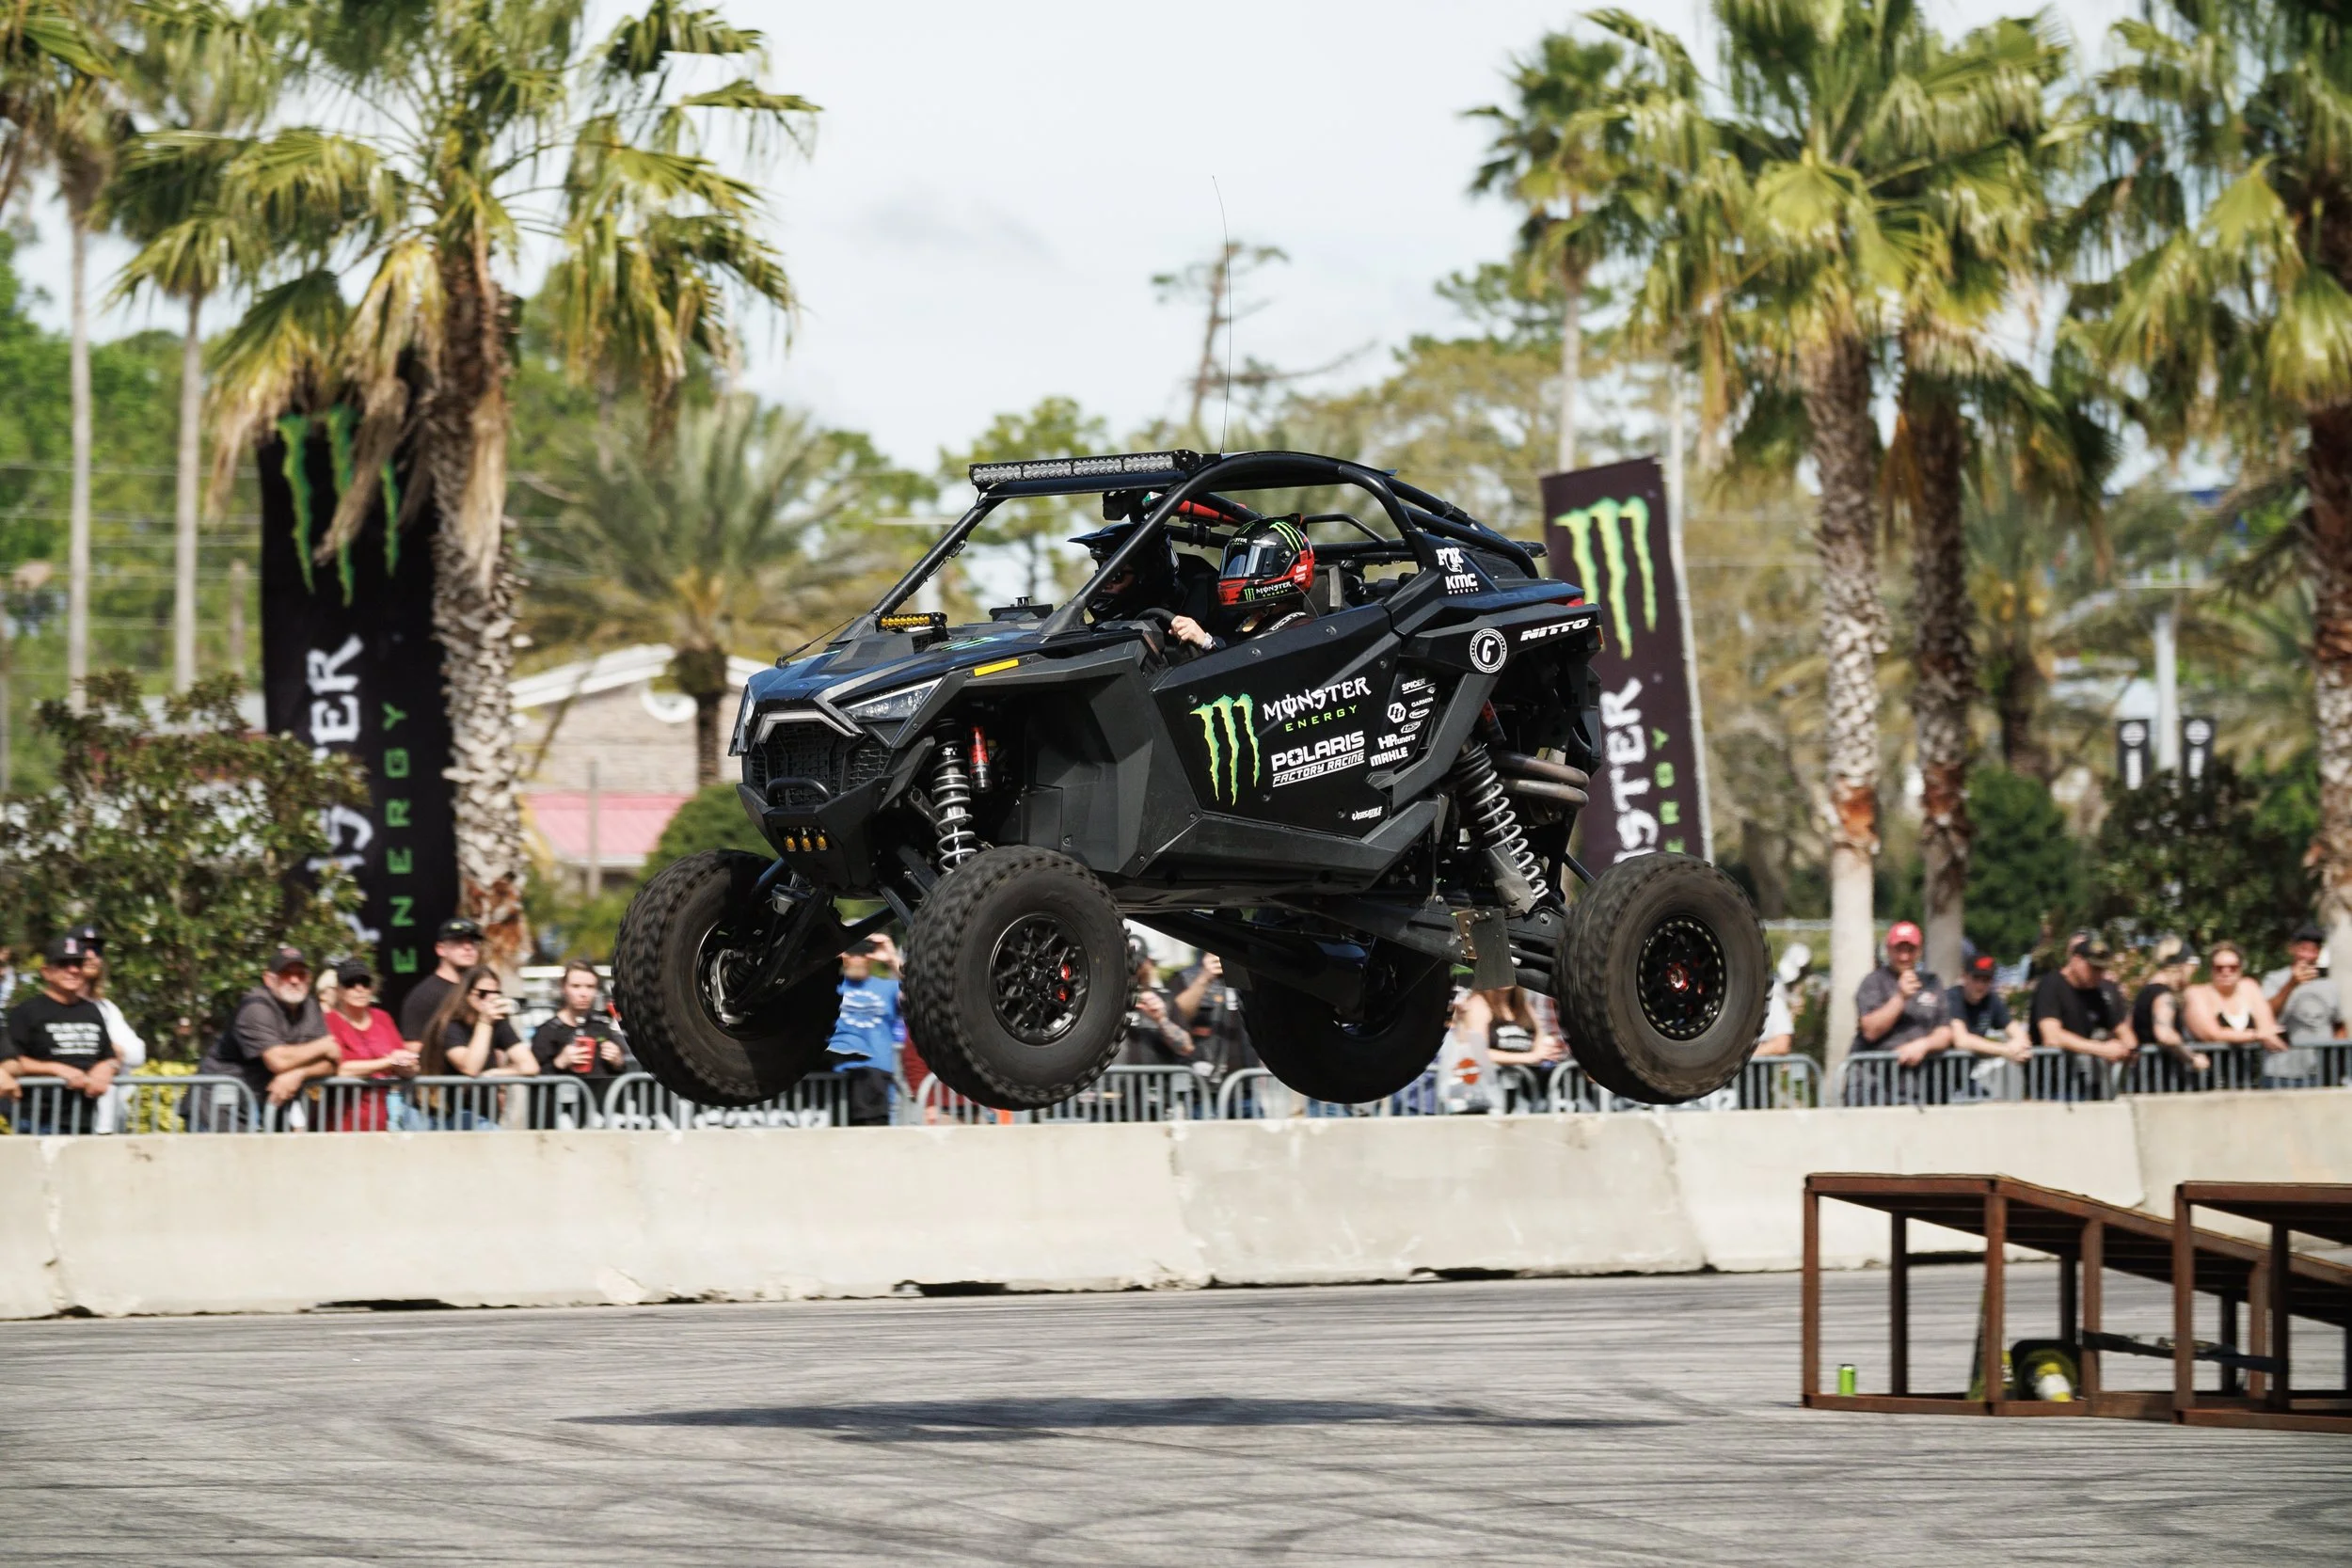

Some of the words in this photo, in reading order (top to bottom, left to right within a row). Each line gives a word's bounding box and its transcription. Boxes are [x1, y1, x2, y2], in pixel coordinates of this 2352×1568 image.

[1445, 573, 1478, 590] KMC
[1520, 618, 1589, 641] NITTO
[1402, 678, 1426, 691] SPICER
[1285, 705, 1358, 732] ENERGY
[1271, 731, 1365, 771] POLARIS
[1370, 747, 1408, 767] MAHLE
[1273, 763, 1324, 785] FACTORY
[1327, 752, 1364, 771] RACING
[382, 702, 417, 974] ENERGY
